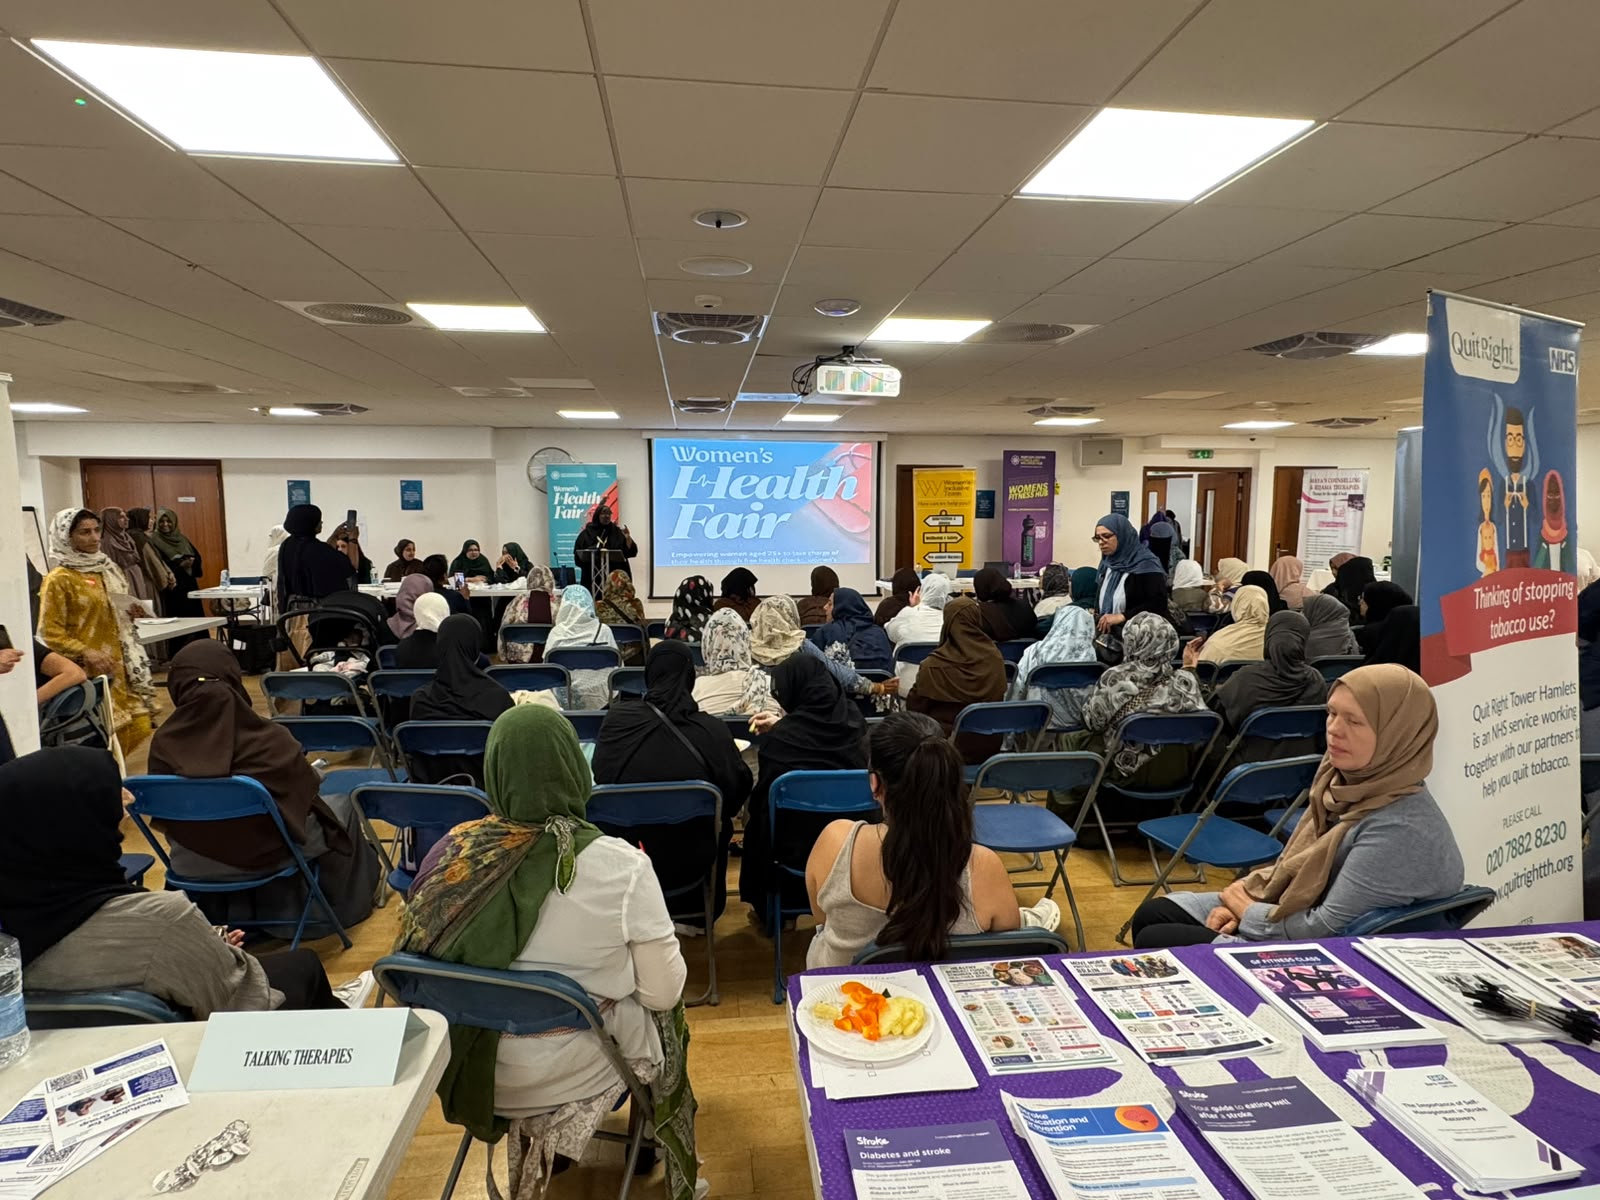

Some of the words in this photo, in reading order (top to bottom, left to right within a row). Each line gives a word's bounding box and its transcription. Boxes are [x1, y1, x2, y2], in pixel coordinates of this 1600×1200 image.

[1451, 331, 1514, 370] QuitRight
[1551, 349, 1576, 373] NHS
[671, 446, 774, 464] Women's
[667, 466, 858, 500] Health
[1008, 482, 1048, 494] WOMENS
[1008, 491, 1034, 500] FITNESS
[1035, 488, 1048, 498] HUB
[553, 492, 603, 505] Health
[554, 506, 584, 519] Fair
[667, 502, 792, 540] Fair
[1474, 584, 1510, 610] Thinking
[1512, 581, 1525, 605] of
[1525, 578, 1574, 601] stopping
[1490, 617, 1526, 640] tobacco
[1529, 608, 1556, 631] use?
[1473, 701, 1491, 724] Quit
[1492, 695, 1508, 717] Right
[1510, 687, 1538, 708] Tower
[1539, 680, 1577, 700] Hamlets
[1473, 733, 1480, 750] is
[1482, 730, 1490, 747] an
[1492, 720, 1508, 741] NHS
[1508, 714, 1539, 734] service
[1542, 704, 1577, 725] working
[1464, 752, 1499, 779] together
[1500, 742, 1516, 767] with
[1516, 738, 1532, 756] our
[1534, 730, 1574, 754] partners
[1482, 777, 1498, 799] help
[1498, 773, 1511, 794] you
[1512, 763, 1529, 784] quit
[1531, 755, 1571, 776] tobacco.
[1502, 810, 1524, 830] PLEASE
[1524, 804, 1542, 822] CALL
[1486, 846, 1504, 876] 020
[1505, 832, 1532, 864] 7882
[1534, 820, 1567, 849] 8230
[1488, 855, 1574, 905] w.quitrightth.org
[243, 1050, 291, 1068] TALKING
[294, 1048, 354, 1065] THERAPIES
[1198, 1111, 1219, 1120] after
[1226, 1110, 1254, 1119] stroke
[1211, 1102, 1234, 1112] guide
[1244, 1100, 1272, 1110] eating
[856, 1136, 890, 1146] Stroke
[860, 1150, 900, 1160] Diabetes
[902, 1149, 920, 1158] and
[922, 1147, 951, 1156] stroke
